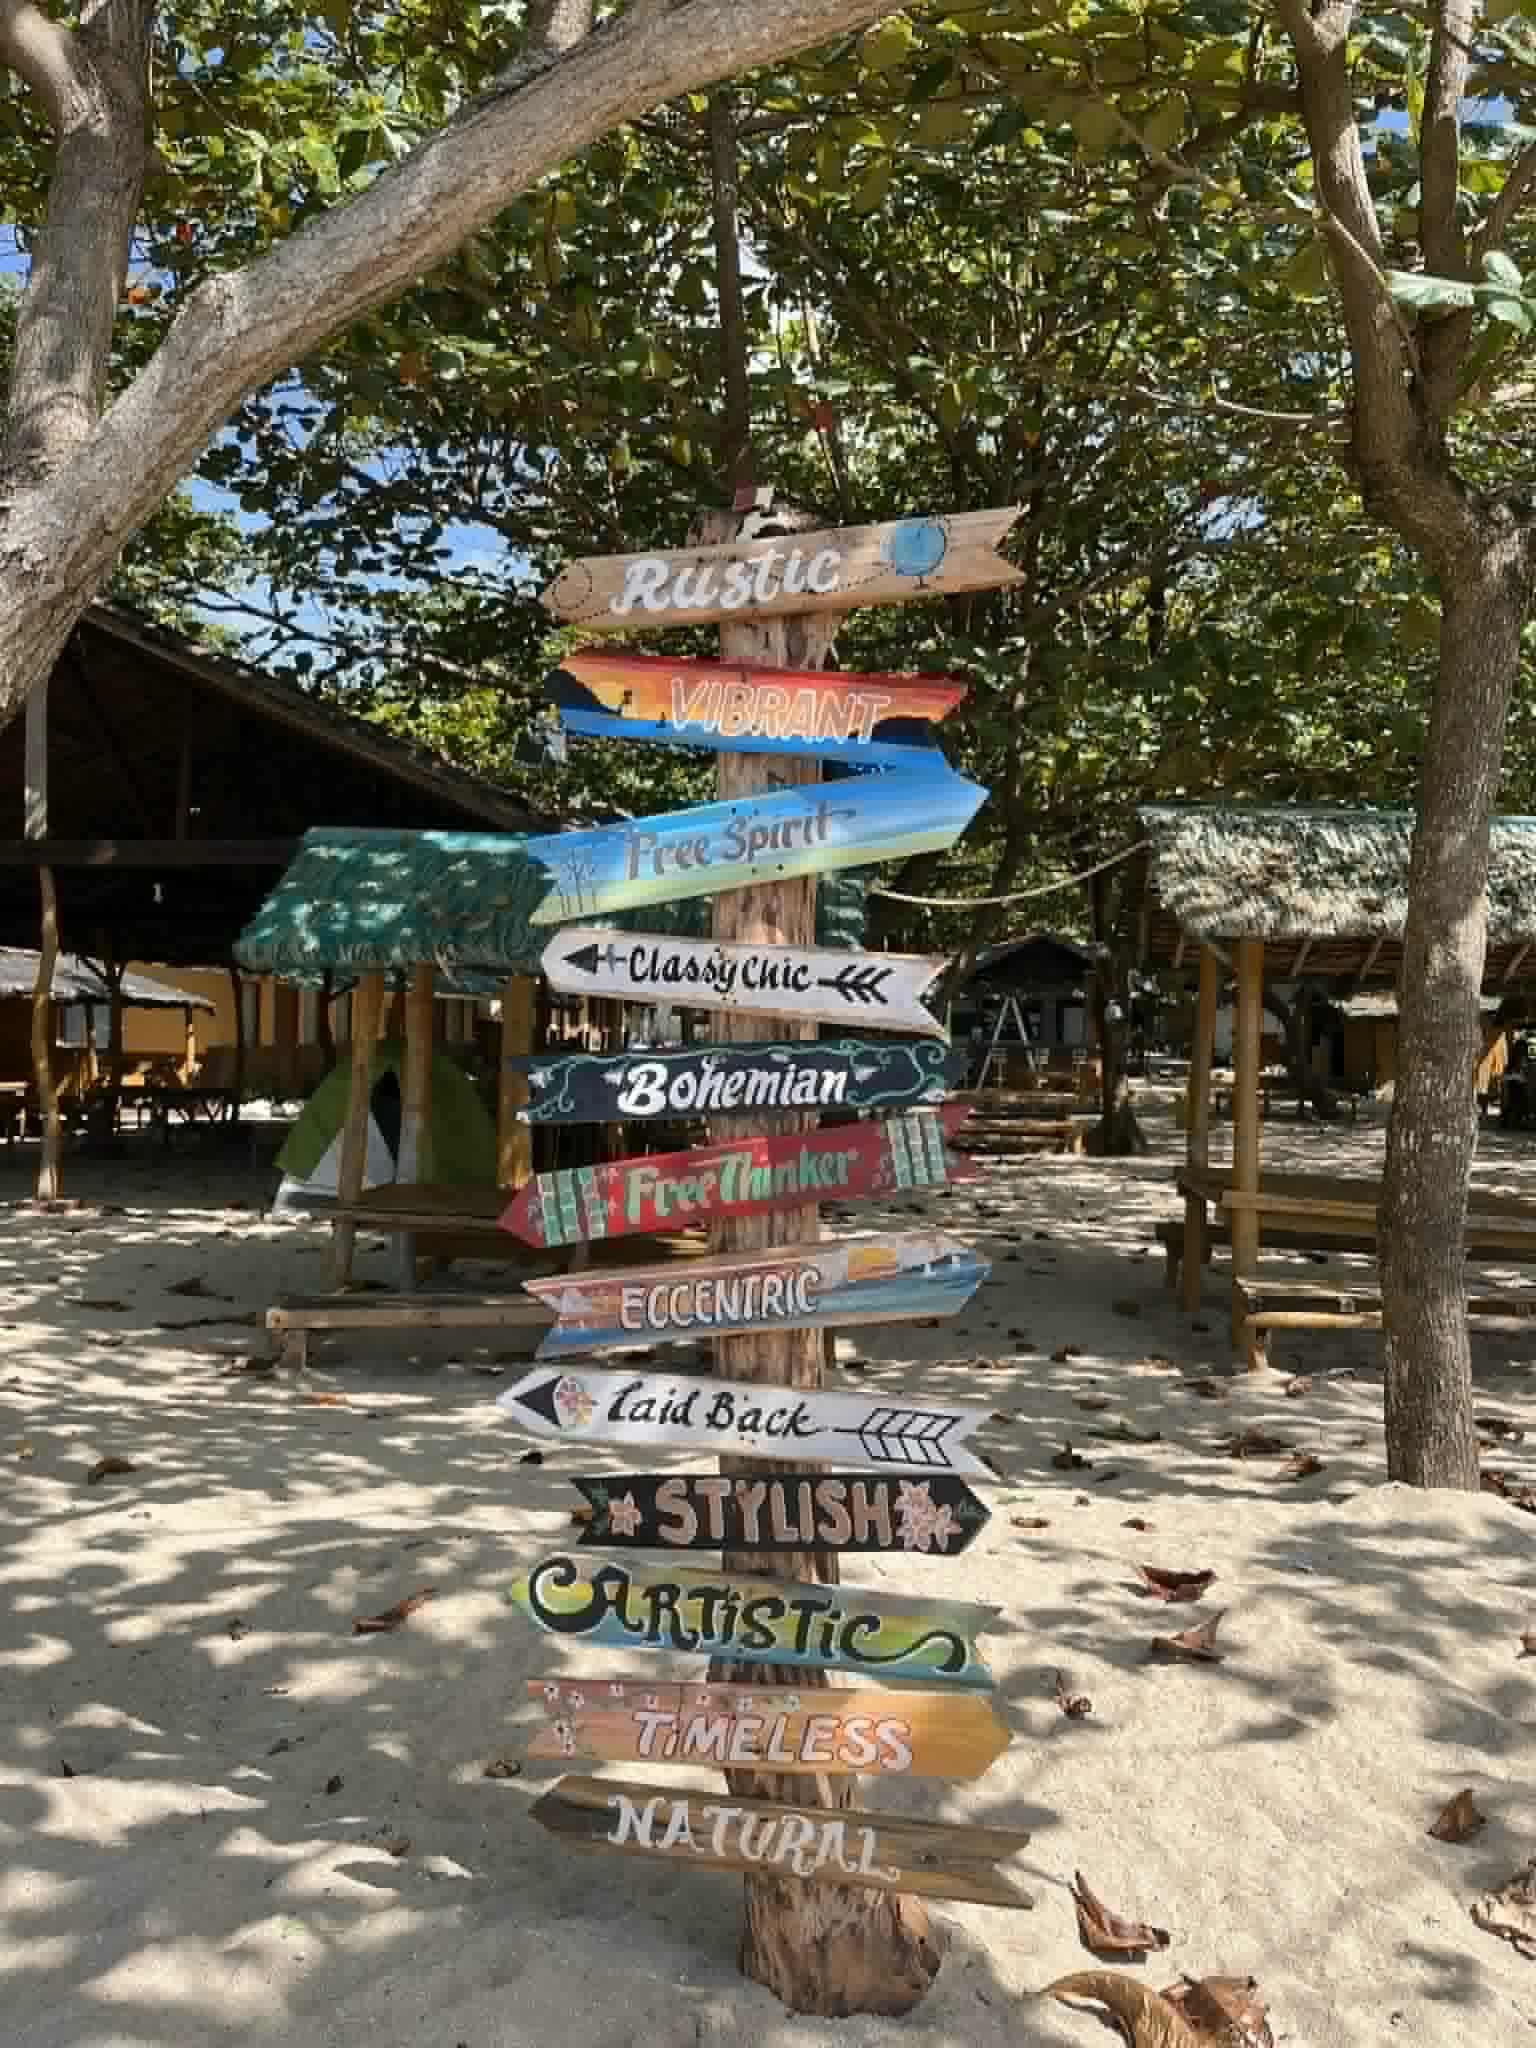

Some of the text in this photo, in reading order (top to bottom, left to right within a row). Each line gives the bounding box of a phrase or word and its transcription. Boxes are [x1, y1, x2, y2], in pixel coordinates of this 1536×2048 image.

[609, 547, 842, 614] Rustic
[671, 677, 891, 744] VIBRANT
[624, 801, 857, 881] Free Spirit
[629, 943, 812, 993] Classy Chic
[616, 1056, 847, 1116] Bohemian
[622, 1146, 860, 1224] Free Thinker
[620, 1267, 822, 1330] ECCENTRIC
[608, 1380, 817, 1438] Laid Back
[655, 1478, 894, 1545] STYLISH
[606, 1794, 901, 1882] NATURAL
